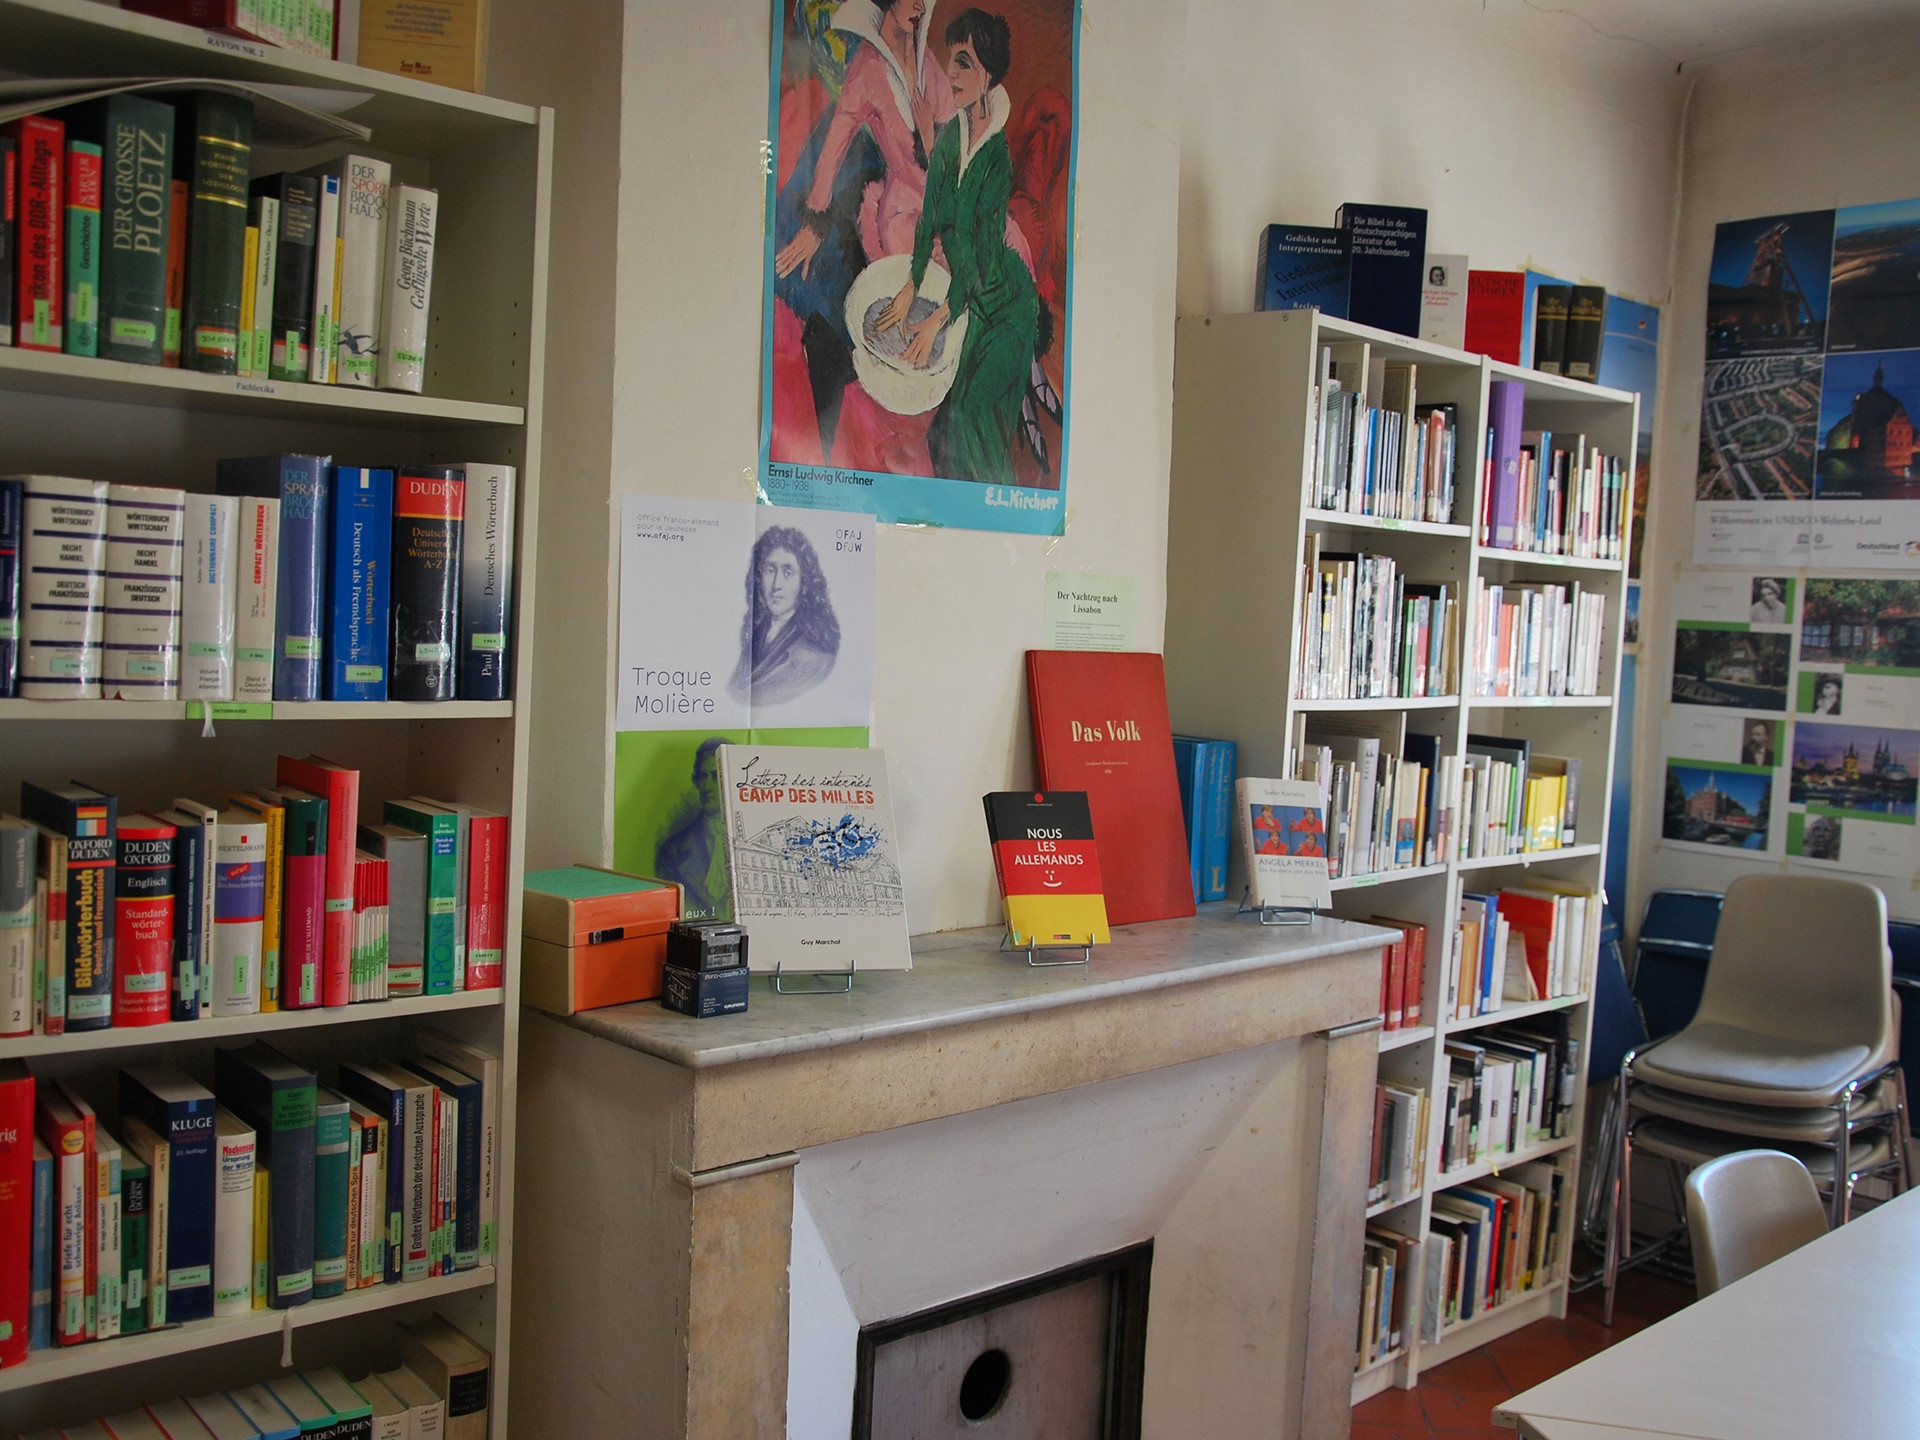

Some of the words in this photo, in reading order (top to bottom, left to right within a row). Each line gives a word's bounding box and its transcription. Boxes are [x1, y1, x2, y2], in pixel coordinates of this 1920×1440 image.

[207, 37, 240, 53] RAYON
[242, 46, 257, 57] NR.
[259, 49, 265, 57] 2
[115, 124, 137, 204] GROSSE
[352, 164, 375, 180] DER
[29, 139, 51, 229] DDR-Alltags
[352, 179, 387, 196] SPORT
[134, 128, 167, 255] PLOETZ
[351, 191, 388, 210] BROCK
[350, 204, 382, 220] HAUS
[112, 207, 133, 250] DER
[398, 200, 416, 255] Büchmann
[414, 203, 432, 245] Worte
[1354, 217, 1366, 226] Die
[1366, 217, 1385, 227] Bibel
[1387, 219, 1395, 227] in
[1395, 219, 1407, 228] der
[1285, 233, 1320, 245] Gedichte
[1321, 237, 1338, 246] und
[1352, 227, 1417, 239] deutschsprachigen
[29, 234, 47, 260] des
[79, 215, 91, 270] Geschichte
[1352, 236, 1383, 246] Literatur
[1384, 238, 1397, 247] des
[1278, 243, 1344, 256] Interpretationen
[1364, 247, 1411, 258] Jahrhunderts
[397, 257, 413, 290] Georg
[411, 247, 431, 310] Geflügelte
[1293, 302, 1321, 310] Reclam
[236, 381, 275, 394] Fachlexika
[284, 469, 310, 483] DER
[768, 465, 795, 479] Ernst
[795, 468, 834, 486] Ludwig
[835, 469, 874, 487] Kirchner
[284, 482, 329, 498] SPRACH
[409, 481, 459, 497] DUDEN
[767, 478, 810, 492] 1880-1938
[283, 495, 322, 510] BROCK
[486, 475, 499, 540] Wörterbuch
[51, 506, 95, 518] WÖRTERBUCH
[126, 512, 170, 523] WÖRTERBUCH
[283, 507, 316, 521] HAUS
[52, 517, 93, 527] WIRTSCHAFT
[209, 503, 217, 536] COMPACT
[637, 513, 662, 523] Office
[663, 515, 720, 527] franco-allemand
[1710, 515, 1760, 526] Willkommen
[1762, 516, 1774, 525] im
[127, 522, 168, 532] WIRTSCHAFT
[254, 504, 264, 550] WÖRTERBUCH
[637, 523, 654, 531] pour
[664, 525, 697, 533] Jeunesse
[637, 532, 685, 542] www.ofaj.org
[836, 528, 862, 541] OFAJ
[61, 544, 83, 553] RECHT
[352, 521, 363, 566] Deutsch
[836, 541, 862, 553] DFJW
[1856, 541, 1901, 551] Deutschland
[59, 553, 84, 563] HANDEL
[136, 549, 158, 558] RECHT
[208, 537, 217, 584] DICTIONNAIRE
[134, 558, 159, 567] HANDEL
[253, 551, 262, 584] COMPACT
[424, 560, 443, 569] A-Z
[351, 568, 362, 583] als
[484, 543, 497, 597] Deutsches
[56, 580, 86, 590] DEUTSCH
[124, 583, 167, 594] FRANZÖSISCH
[365, 559, 377, 625] Wörterbuch
[131, 593, 160, 603] DEUTSCH
[1057, 591, 1070, 600] Der
[1071, 591, 1101, 604] Nachtzug
[1102, 594, 1118, 603] nach
[1073, 604, 1102, 615] Lissabon
[349, 585, 362, 662] Fremdsprache
[482, 653, 493, 677] Paul
[632, 667, 712, 692] Troque
[635, 692, 715, 714] Molière
[1071, 720, 1103, 742] Das
[1105, 720, 1142, 742] Volk
[736, 755, 788, 789] Lettres
[791, 773, 817, 788] des
[819, 770, 874, 789] internés
[738, 787, 785, 804] CAMP
[788, 787, 818, 804] DES
[821, 789, 876, 806] MILLES
[1026, 828, 1063, 840] NOUS
[68, 838, 112, 850] OXFORD
[125, 841, 171, 854] DUDEN
[217, 844, 266, 854] BERTELSMANN
[1037, 841, 1057, 853] LES
[71, 848, 110, 860] DUDEN
[124, 853, 170, 865] OXFORD
[1015, 853, 1084, 866] ALLEMANDS
[230, 863, 250, 877] neue
[1258, 857, 1294, 867] ANGELA
[1294, 859, 1326, 869] MERKEL
[128, 877, 167, 888] Englisch
[94, 868, 105, 920] Französisch
[125, 908, 169, 920] Standard-
[685, 909, 707, 919] eux
[76, 868, 94, 989] Bildwörterbuch
[94, 921, 104, 938] und
[131, 919, 165, 929] wörter-
[135, 931, 159, 940] buch
[800, 938, 814, 947] Guy
[431, 915, 453, 975] PONS
[93, 939, 103, 975] Deutsch
[704, 970, 739, 980] steno-cassette
[738, 967, 748, 977] 30
[723, 1001, 746, 1009] GRUNDIG
[12, 1010, 21, 1022] 2
[414, 1093, 426, 1135] Aussprache
[171, 1115, 213, 1132] KLUGE
[186, 1147, 208, 1156] Auflage
[222, 1142, 254, 1155] Mackensen
[413, 1135, 424, 1170] deutschen
[222, 1154, 251, 1164] Ursprung
[99, 1164, 107, 1192] DUDEN
[413, 1170, 423, 1183] der
[128, 1180, 137, 1199] kleine
[135, 1181, 144, 1211] DUDEN
[74, 1187, 82, 1218] Anlässe
[129, 1199, 137, 1212] Der
[349, 1187, 358, 1229] deutschen
[411, 1184, 424, 1222] Wörterbuch
[64, 1205, 73, 1225] echt
[63, 1226, 72, 1242] für
[411, 1223, 423, 1249] Großes
[73, 1219, 84, 1268] schwierige
[63, 1243, 72, 1271] Briefe
[348, 1244, 357, 1279] dtv-Atlas
[300, 1426, 337, 1440] DUDEN
[337, 1421, 372, 1435] DUDEN
